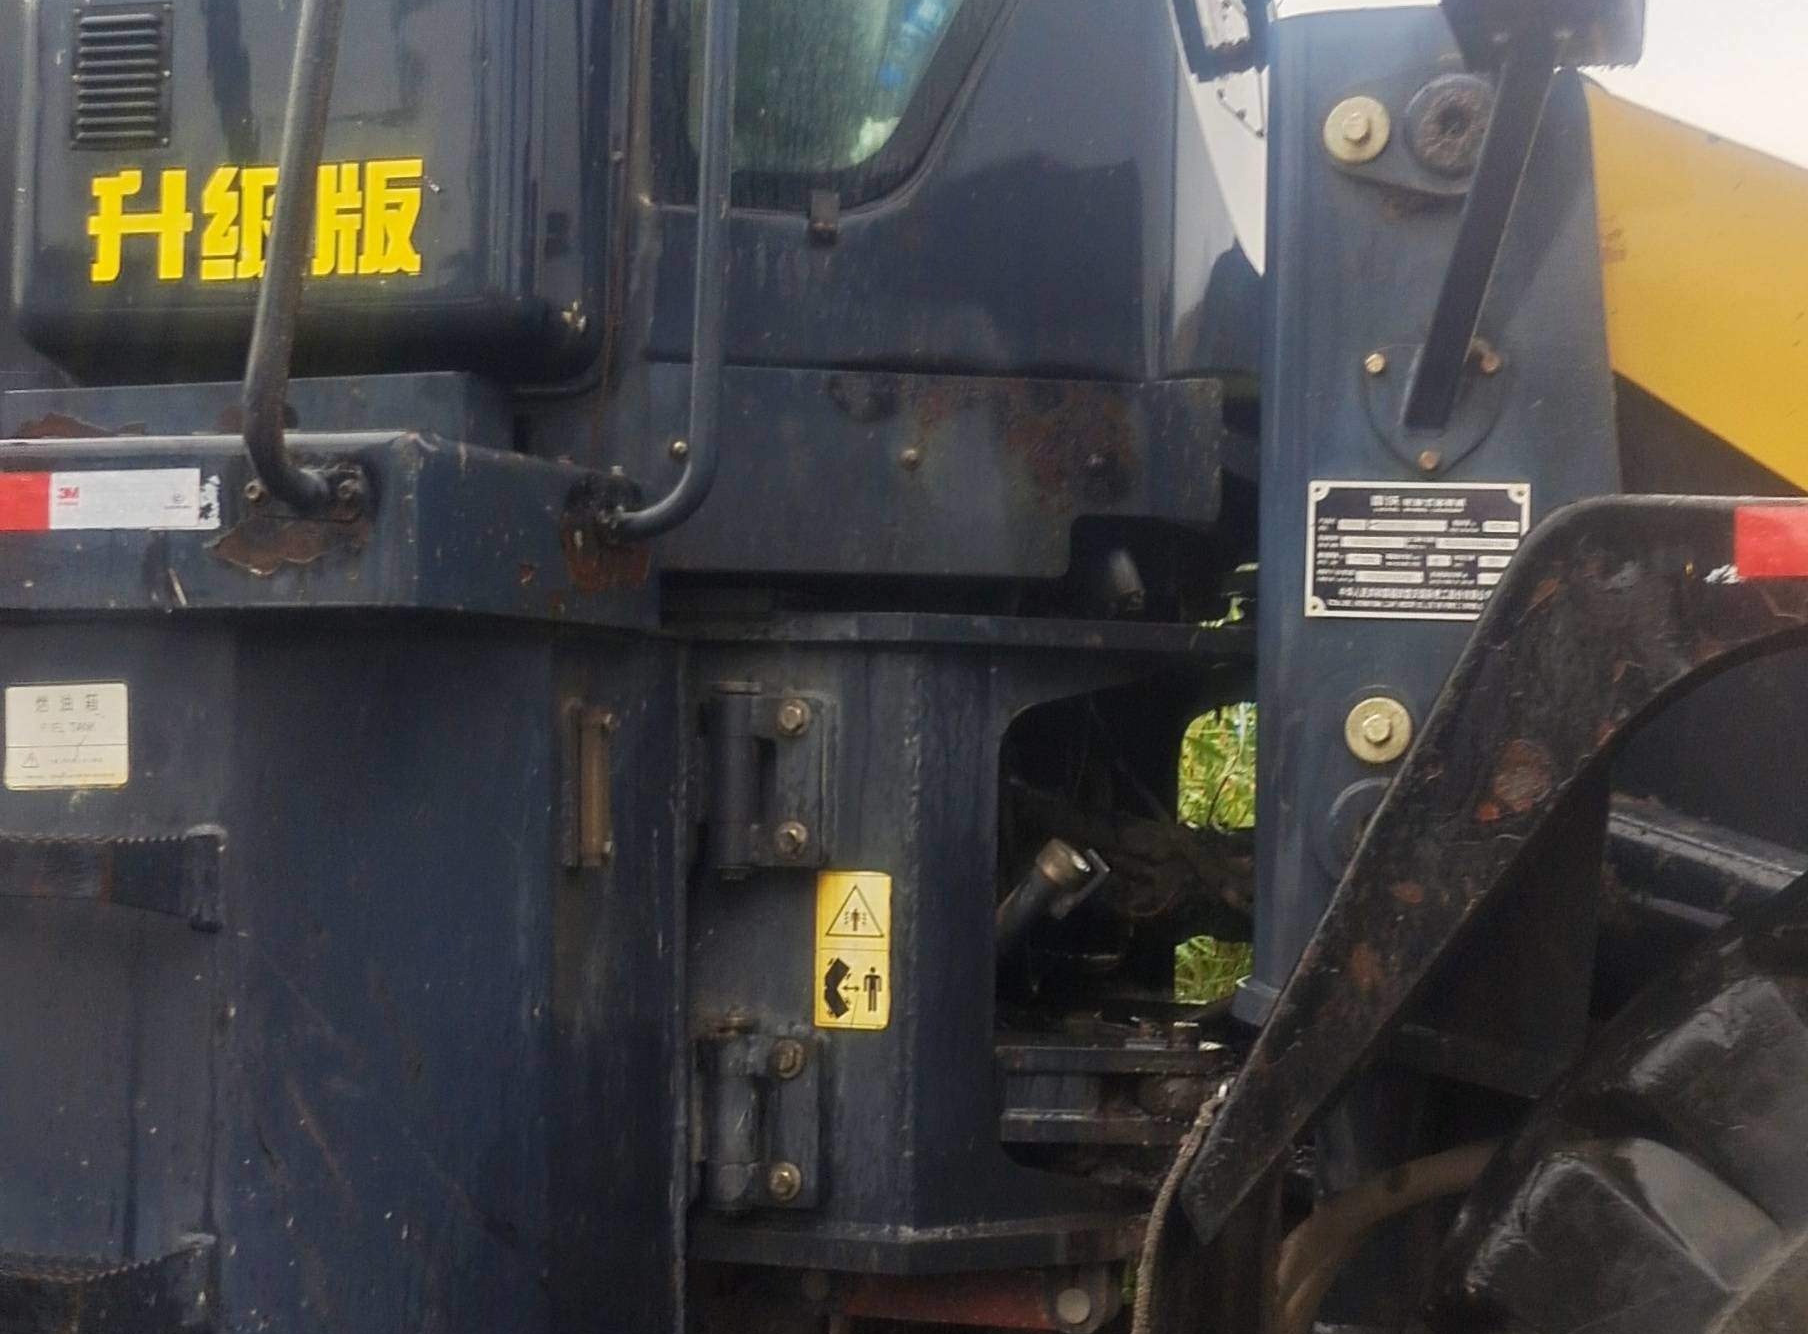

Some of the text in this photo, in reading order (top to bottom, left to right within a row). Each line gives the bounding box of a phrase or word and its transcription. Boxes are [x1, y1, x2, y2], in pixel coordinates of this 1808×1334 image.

[87, 158, 423, 282] 升级版
[57, 486, 79, 500] 3M
